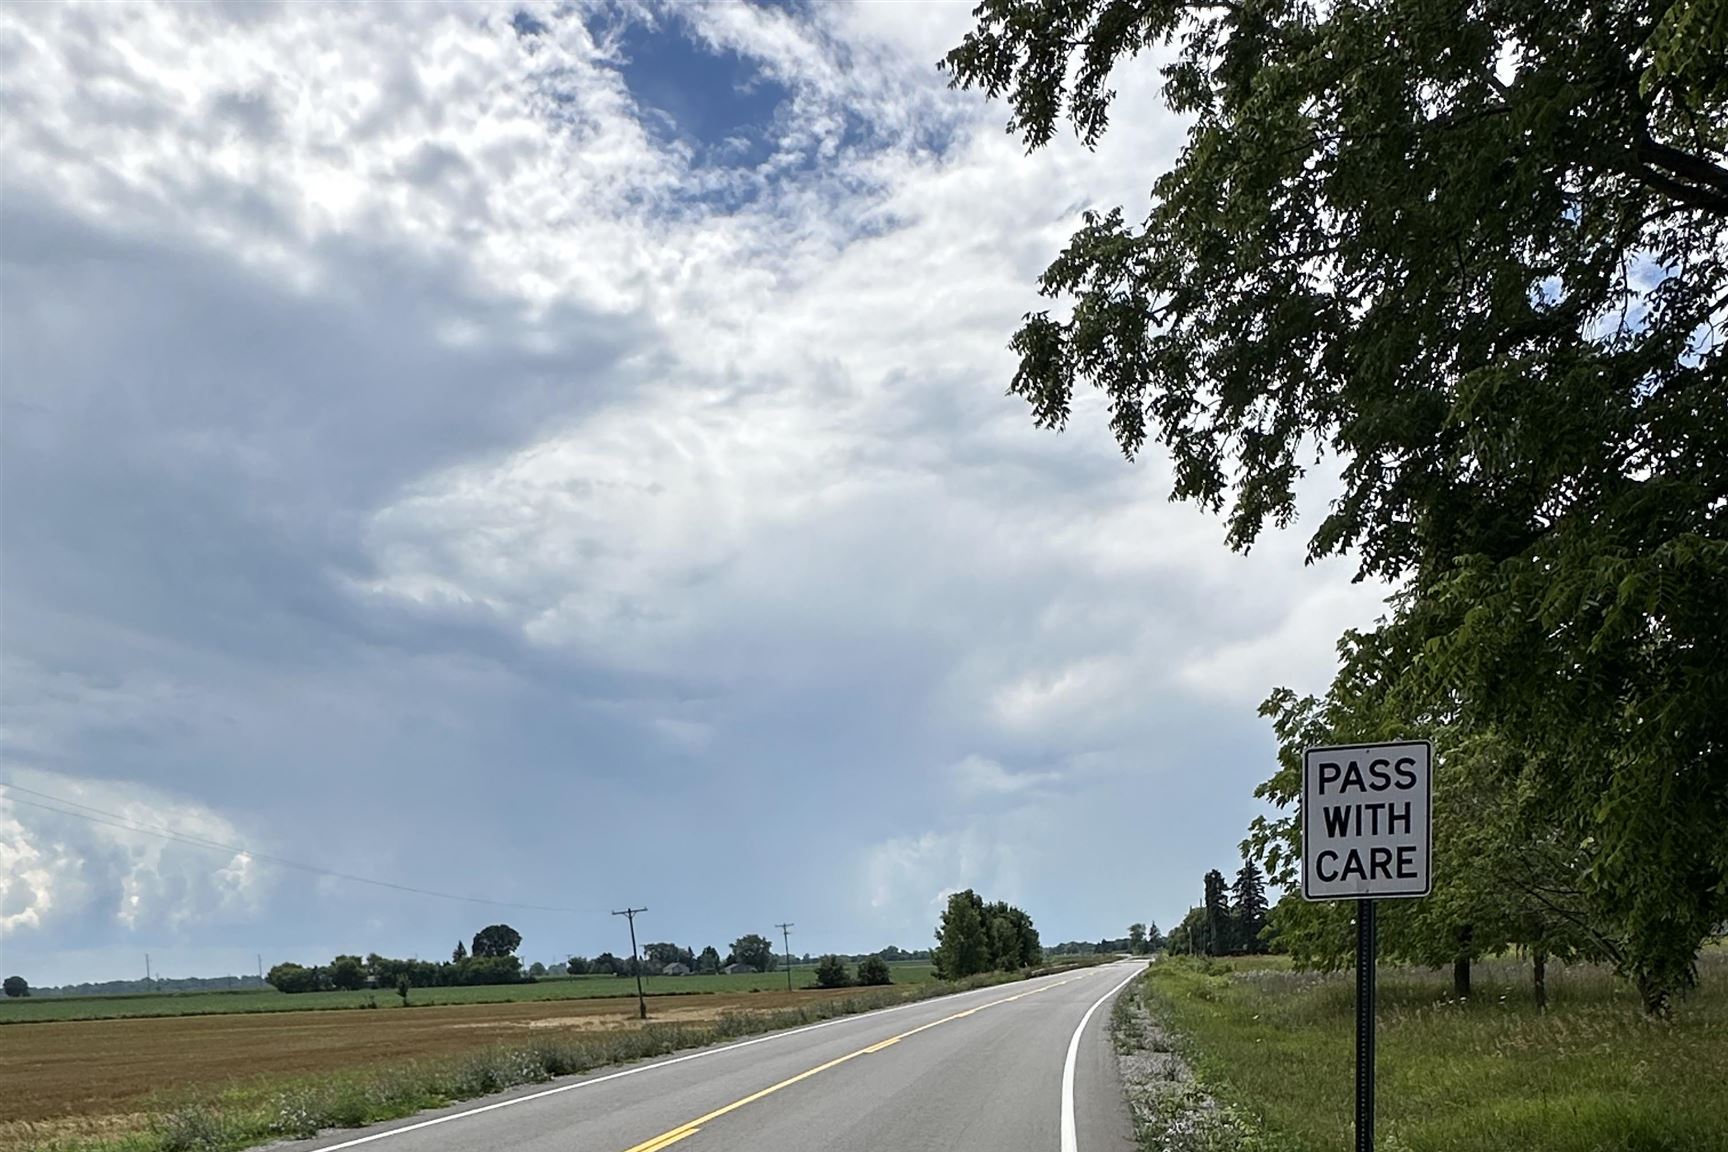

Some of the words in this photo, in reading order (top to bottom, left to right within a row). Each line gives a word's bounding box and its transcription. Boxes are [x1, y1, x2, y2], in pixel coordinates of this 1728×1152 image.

[1318, 757, 1418, 796] PASS
[1322, 801, 1412, 838] WITH
[1315, 845, 1418, 883] CARE
